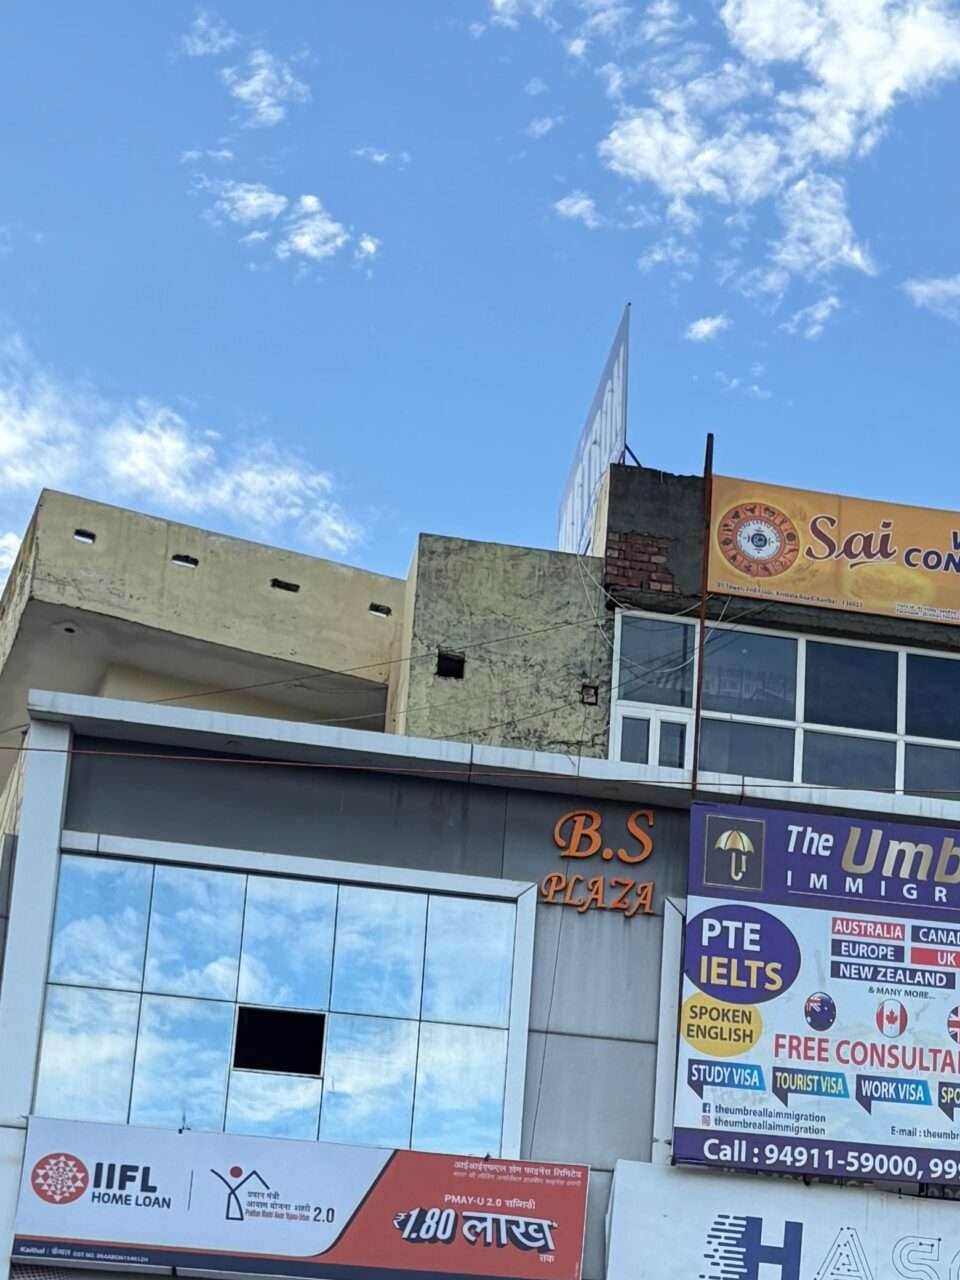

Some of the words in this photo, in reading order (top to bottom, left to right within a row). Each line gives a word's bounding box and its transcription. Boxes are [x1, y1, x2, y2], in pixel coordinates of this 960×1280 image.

[805, 515, 898, 568] Sai
[786, 824, 834, 857] The
[540, 871, 657, 917] PLAZA
[701, 918, 762, 952] PTE
[834, 919, 903, 940] AUSTRALIA
[841, 941, 895, 960] EUROPE
[936, 953, 957, 967] UK
[700, 955, 783, 991] IELTS
[839, 963, 876, 980] NEW
[877, 966, 947, 987] ZEALAND
[877, 987, 903, 997] MANY
[688, 1005, 752, 1025] SPOKEN
[686, 1023, 755, 1044] ENGLISH
[774, 1033, 829, 1062] FREE
[691, 1063, 731, 1084] STUDY
[732, 1067, 760, 1087] VISA
[775, 1071, 819, 1092] TOURIST
[820, 1076, 845, 1095] VISA
[861, 1079, 897, 1100] WORK
[898, 1083, 925, 1101] VISA
[703, 1138, 747, 1163] Call
[93, 1161, 157, 1195] IIFL
[90, 1191, 135, 1207] HOME
[135, 1194, 172, 1211] LOAN
[444, 1193, 485, 1207] PMAY-U
[486, 1197, 502, 1208] 2.0
[313, 1206, 336, 1224] 2.0
